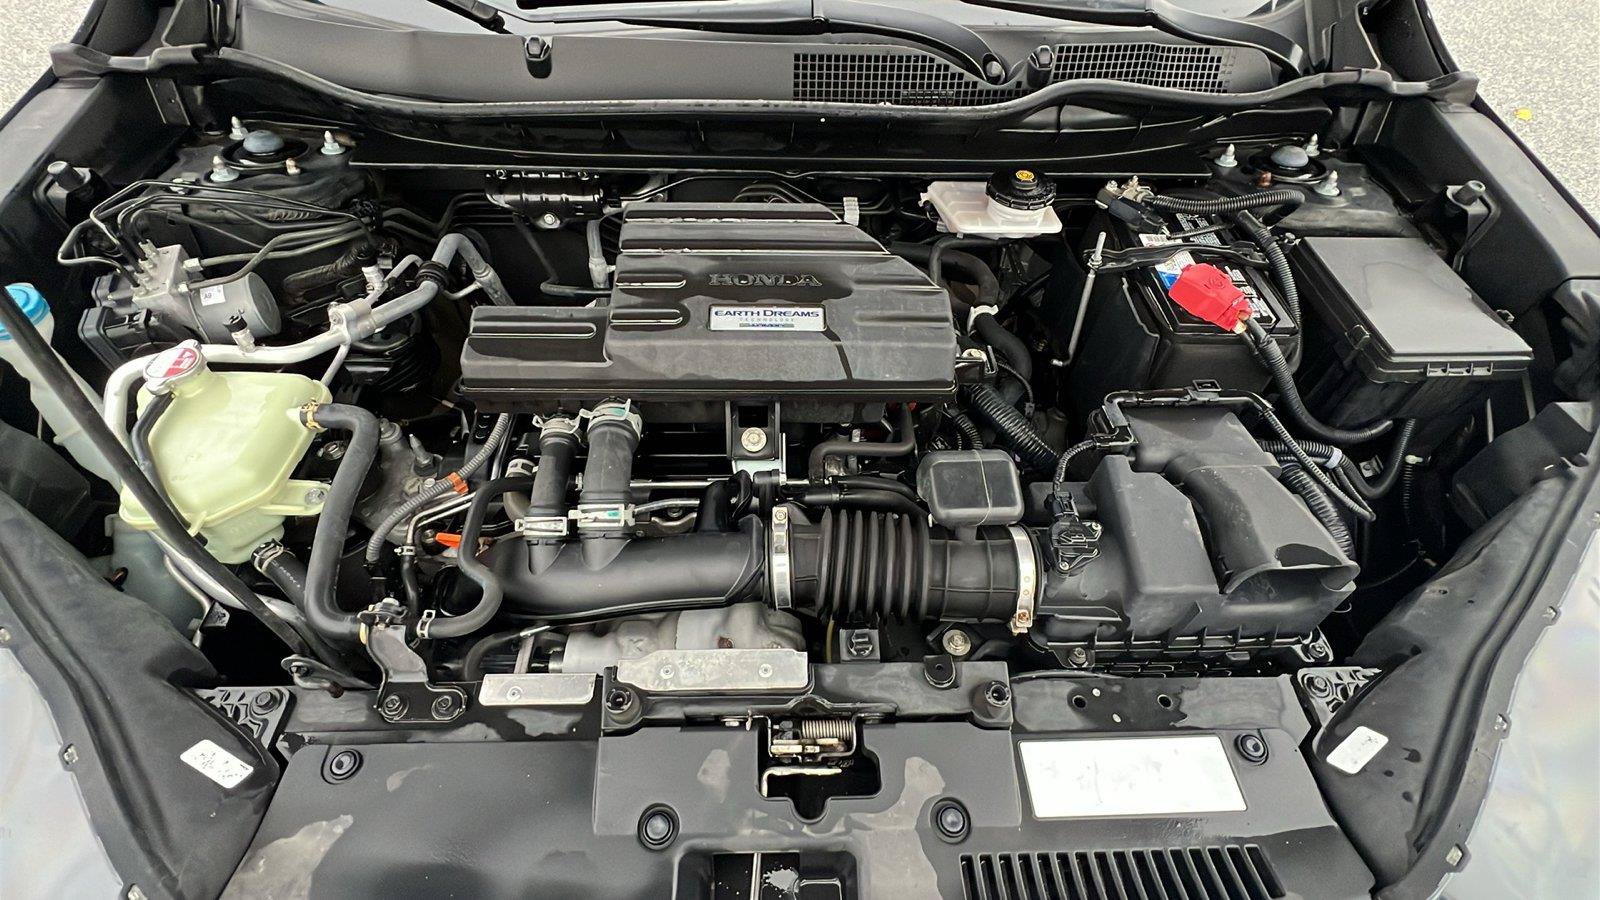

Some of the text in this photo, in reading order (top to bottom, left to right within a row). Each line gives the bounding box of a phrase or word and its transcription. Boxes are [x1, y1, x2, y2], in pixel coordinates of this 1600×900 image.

[709, 273, 822, 287] HONDA
[714, 309, 820, 317] EARTH DREAMS
